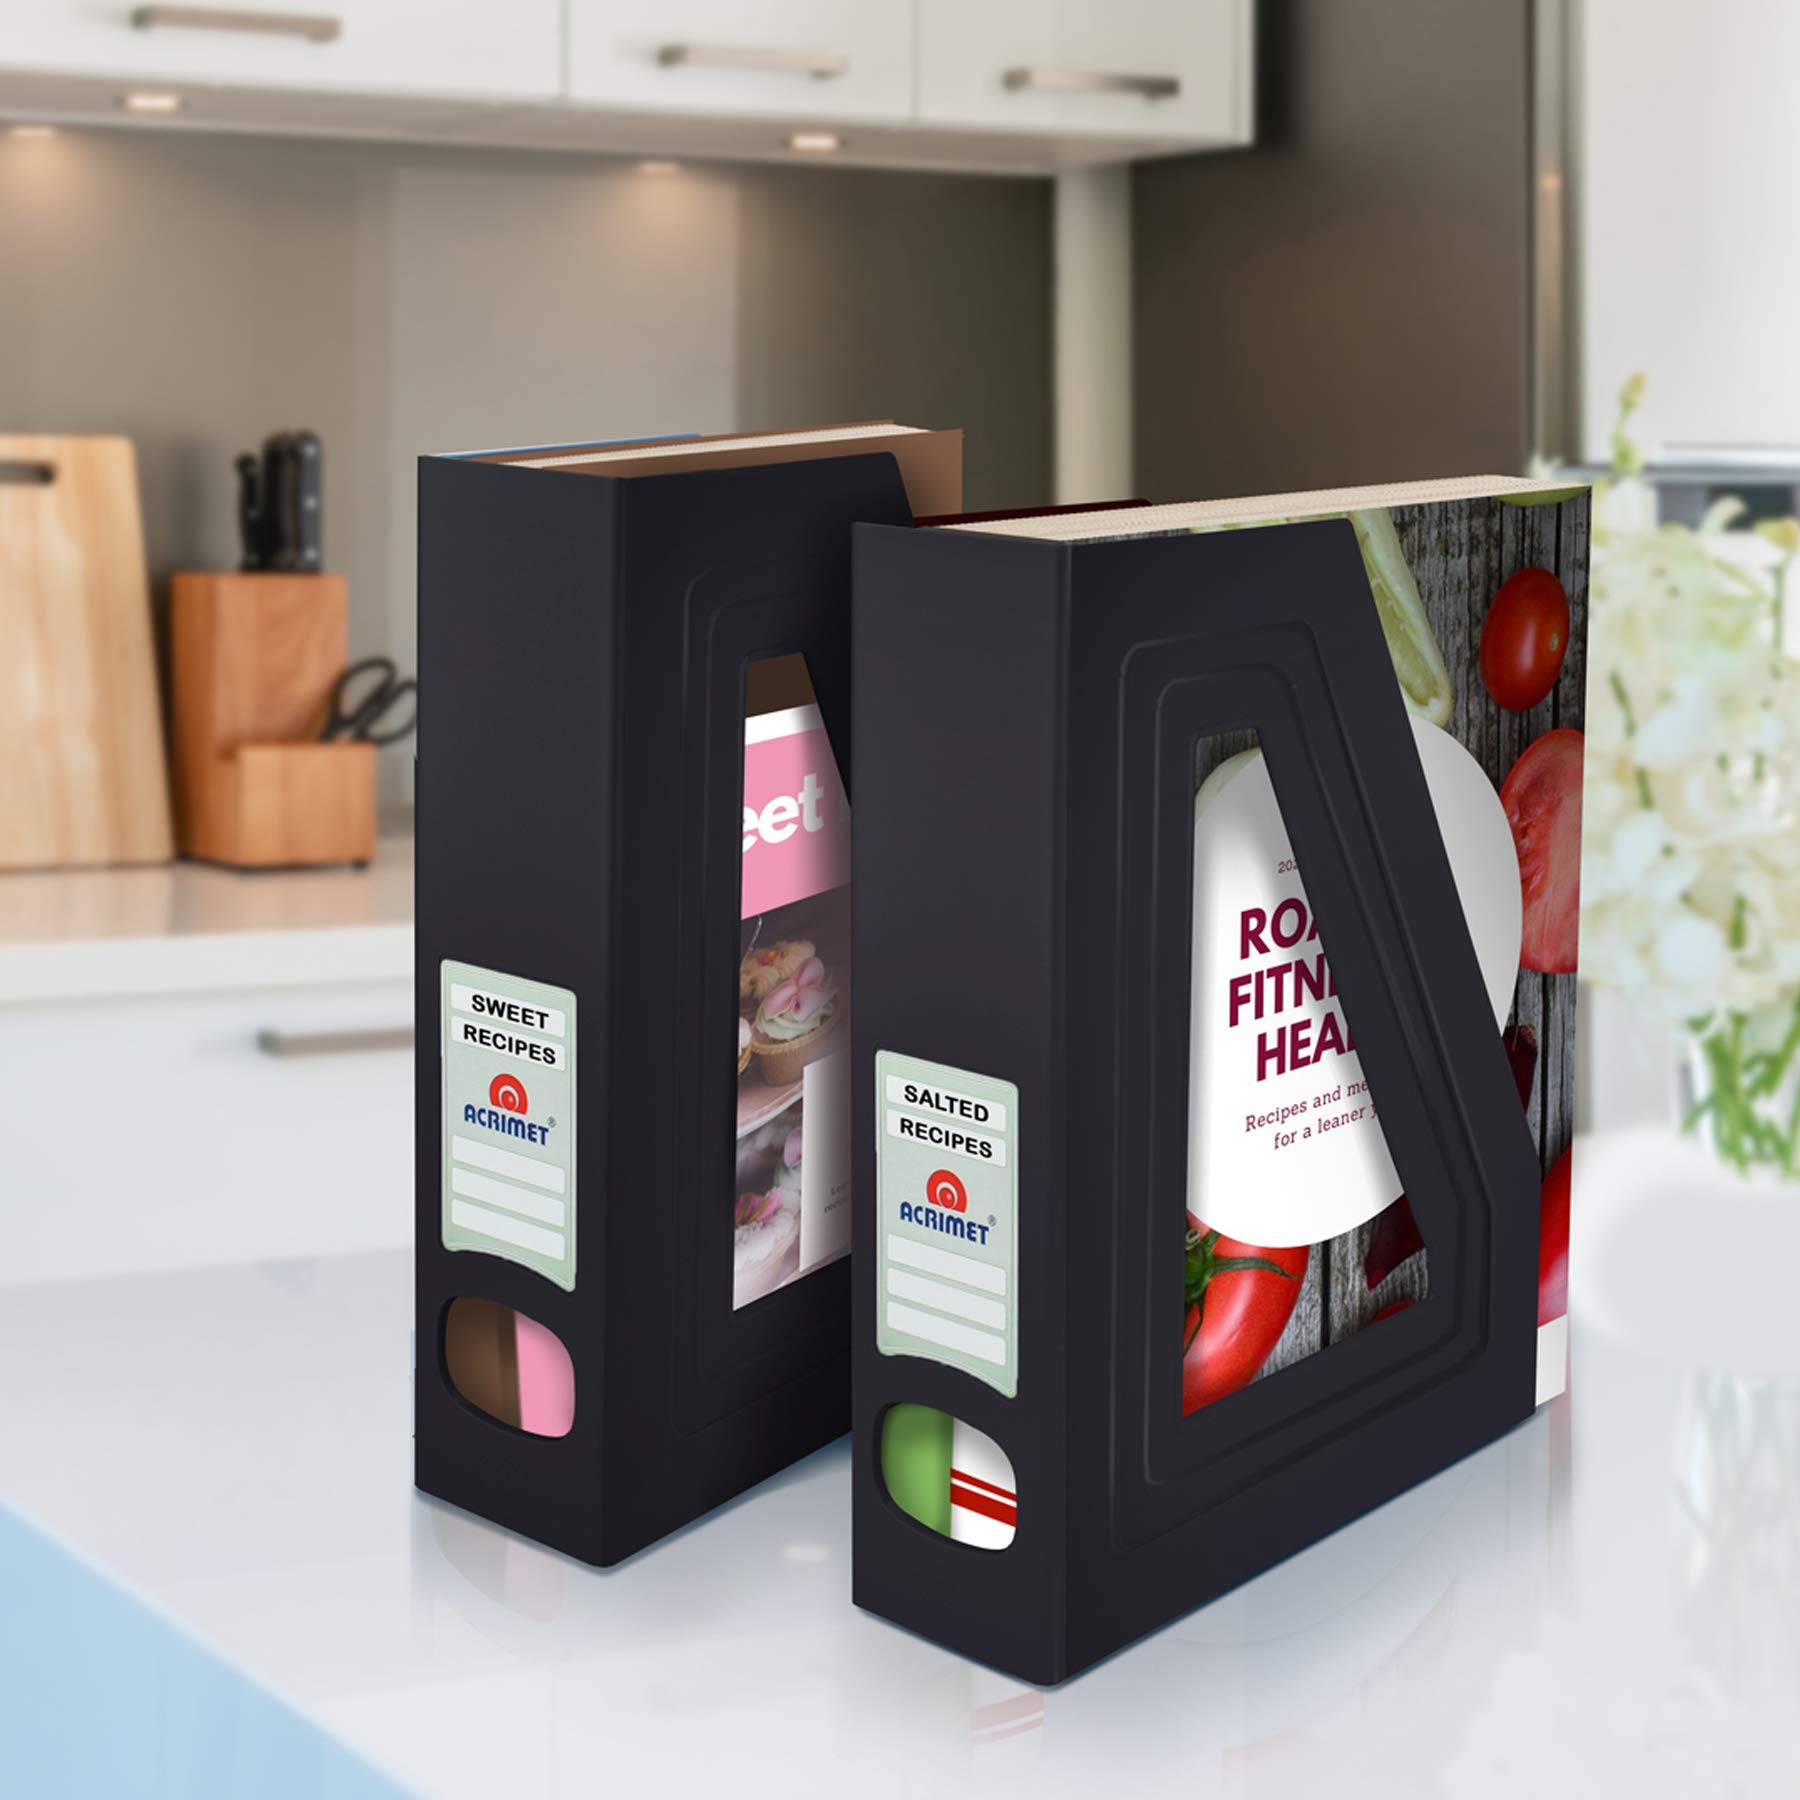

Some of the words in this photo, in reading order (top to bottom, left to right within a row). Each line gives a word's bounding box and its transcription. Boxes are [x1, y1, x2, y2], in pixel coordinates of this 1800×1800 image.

[472, 995, 549, 1030] SWEET
[464, 1023, 556, 1065] RECIPES
[1257, 1011, 1357, 1082] HEA
[904, 1085, 989, 1122] SALTED
[1245, 1099, 1307, 1132] Recipes
[1312, 1085, 1342, 1109] and
[464, 1104, 549, 1146] ACRIMET
[900, 1117, 992, 1159] RECIPES
[1273, 1131, 1297, 1150] for
[1302, 1125, 1313, 1139] a
[1317, 1104, 1366, 1134] leaner
[900, 1201, 989, 1245] ACRIMET
